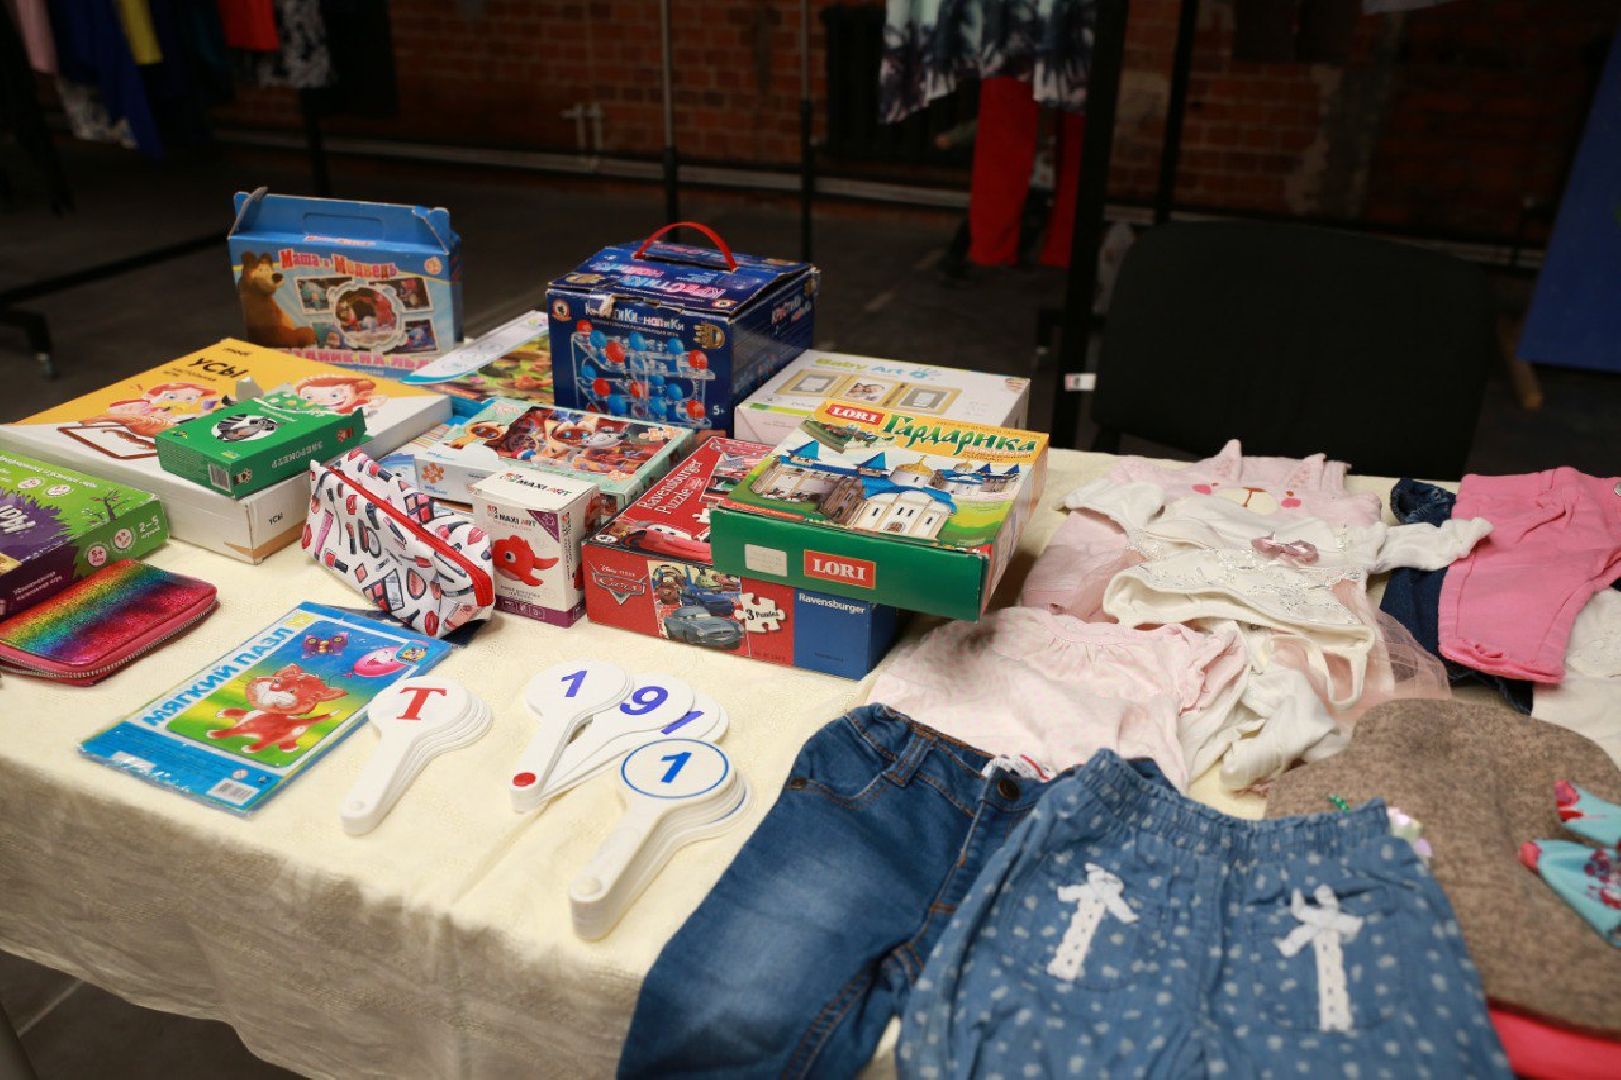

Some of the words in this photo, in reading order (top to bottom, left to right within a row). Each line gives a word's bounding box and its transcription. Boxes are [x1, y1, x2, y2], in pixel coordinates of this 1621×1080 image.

[278, 248, 320, 269] Маша
[331, 253, 399, 280] Медведь
[186, 356, 250, 379] УСЫ
[815, 357, 868, 370] Baby
[871, 364, 904, 376] Art
[711, 404, 727, 417] 5+
[832, 406, 879, 423] LORI
[882, 413, 1037, 456] Гардарика
[637, 459, 703, 509] Ravensburger
[654, 487, 693, 515] Puzzle
[267, 511, 285, 526] УСЫ
[813, 558, 866, 580] LORI
[745, 608, 756, 621] 3
[799, 592, 866, 616] Ravensburger
[143, 662, 241, 727] МЯГКИЙ
[236, 626, 295, 668] ПАЗЛ
[560, 670, 588, 698] 1
[618, 685, 670, 716] 9
[660, 751, 693, 783] 1
